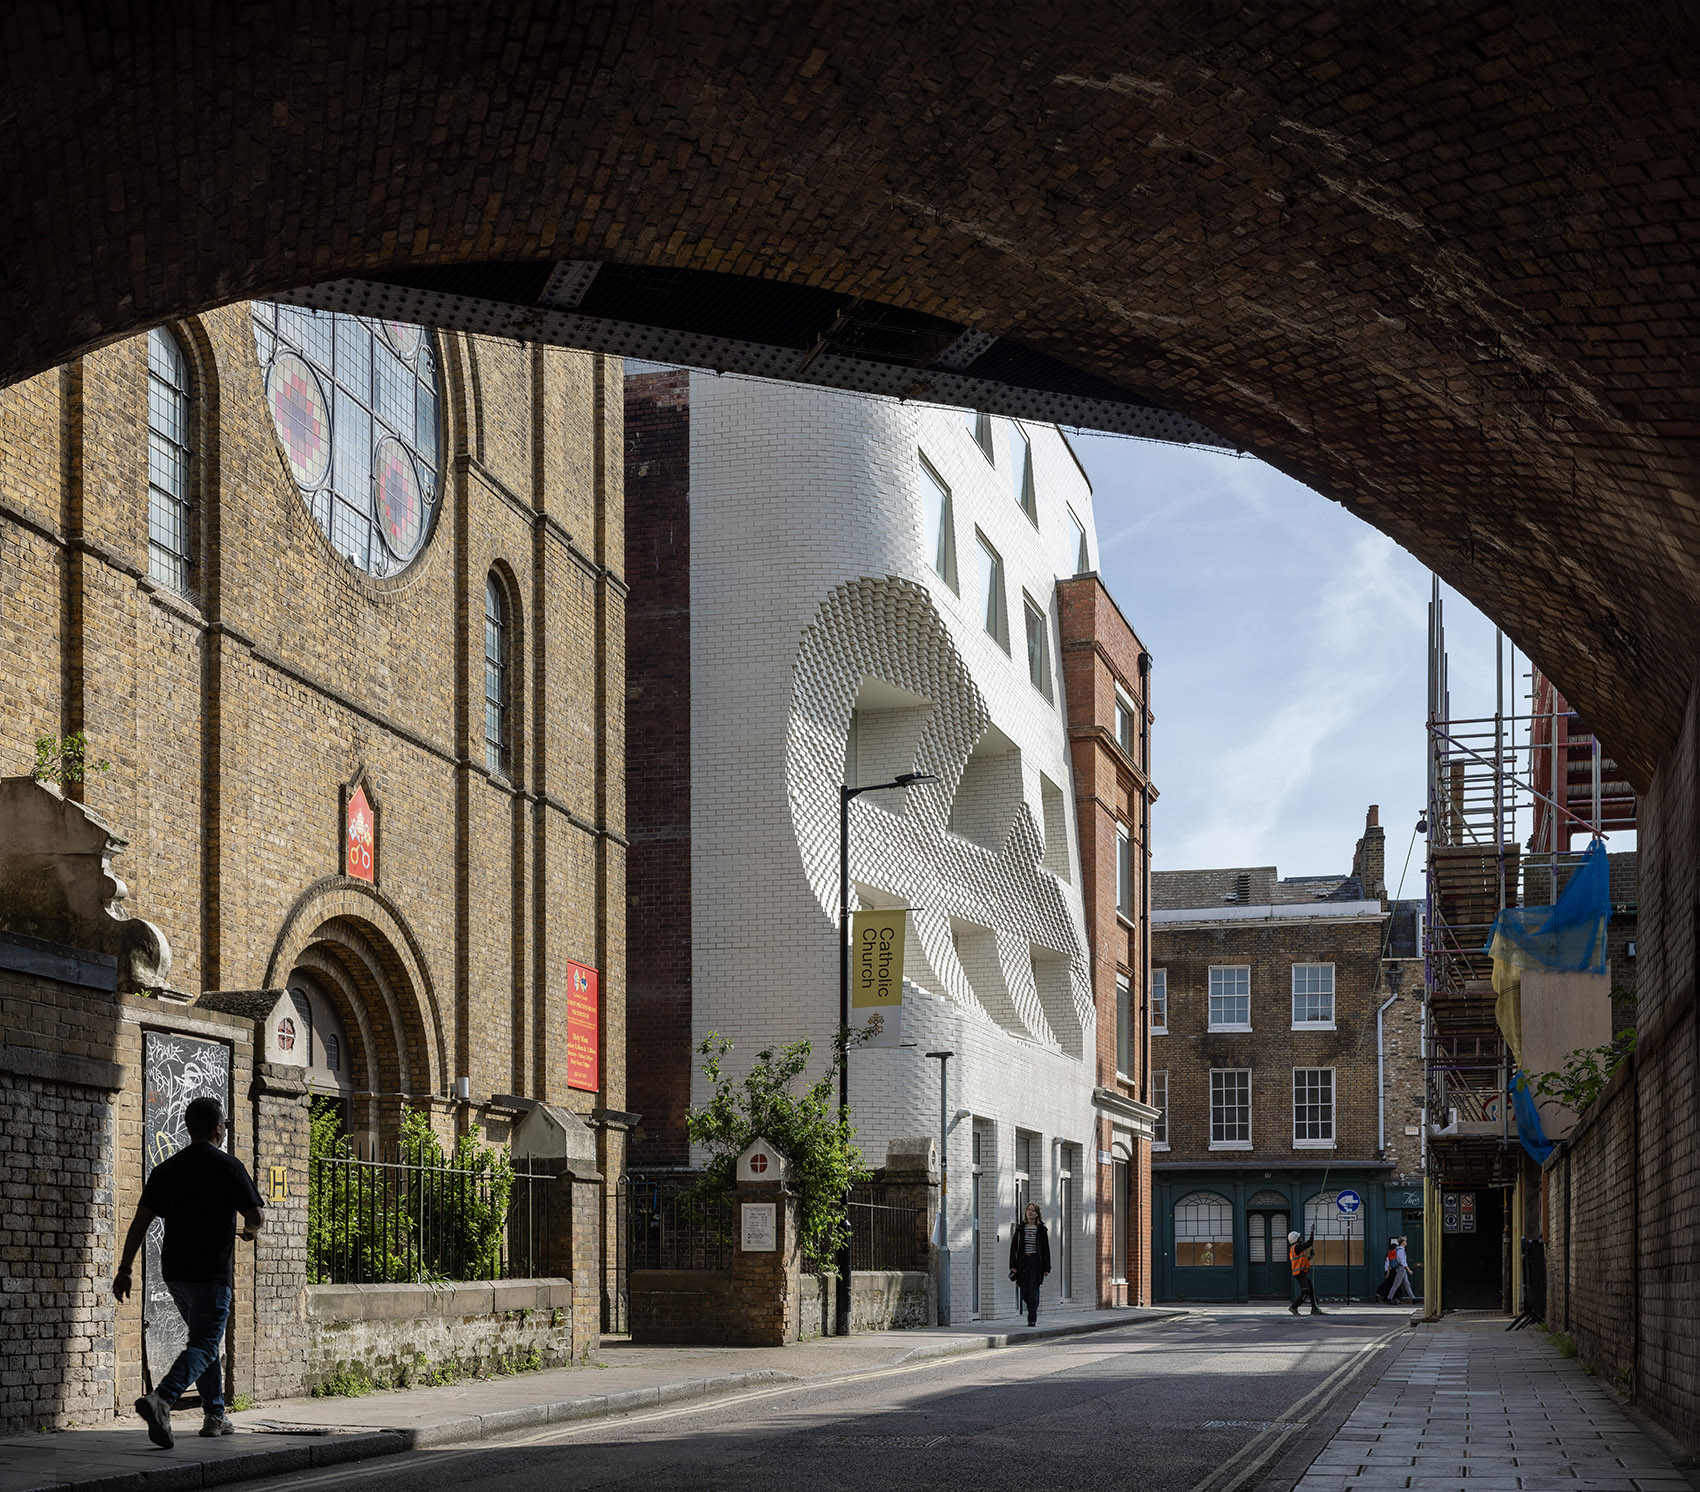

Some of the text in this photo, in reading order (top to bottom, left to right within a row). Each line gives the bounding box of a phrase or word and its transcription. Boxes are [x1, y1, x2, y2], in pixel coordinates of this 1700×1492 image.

[861, 928, 878, 988] Church
[878, 927, 895, 997] Catholic
[273, 1170, 284, 1198] H
